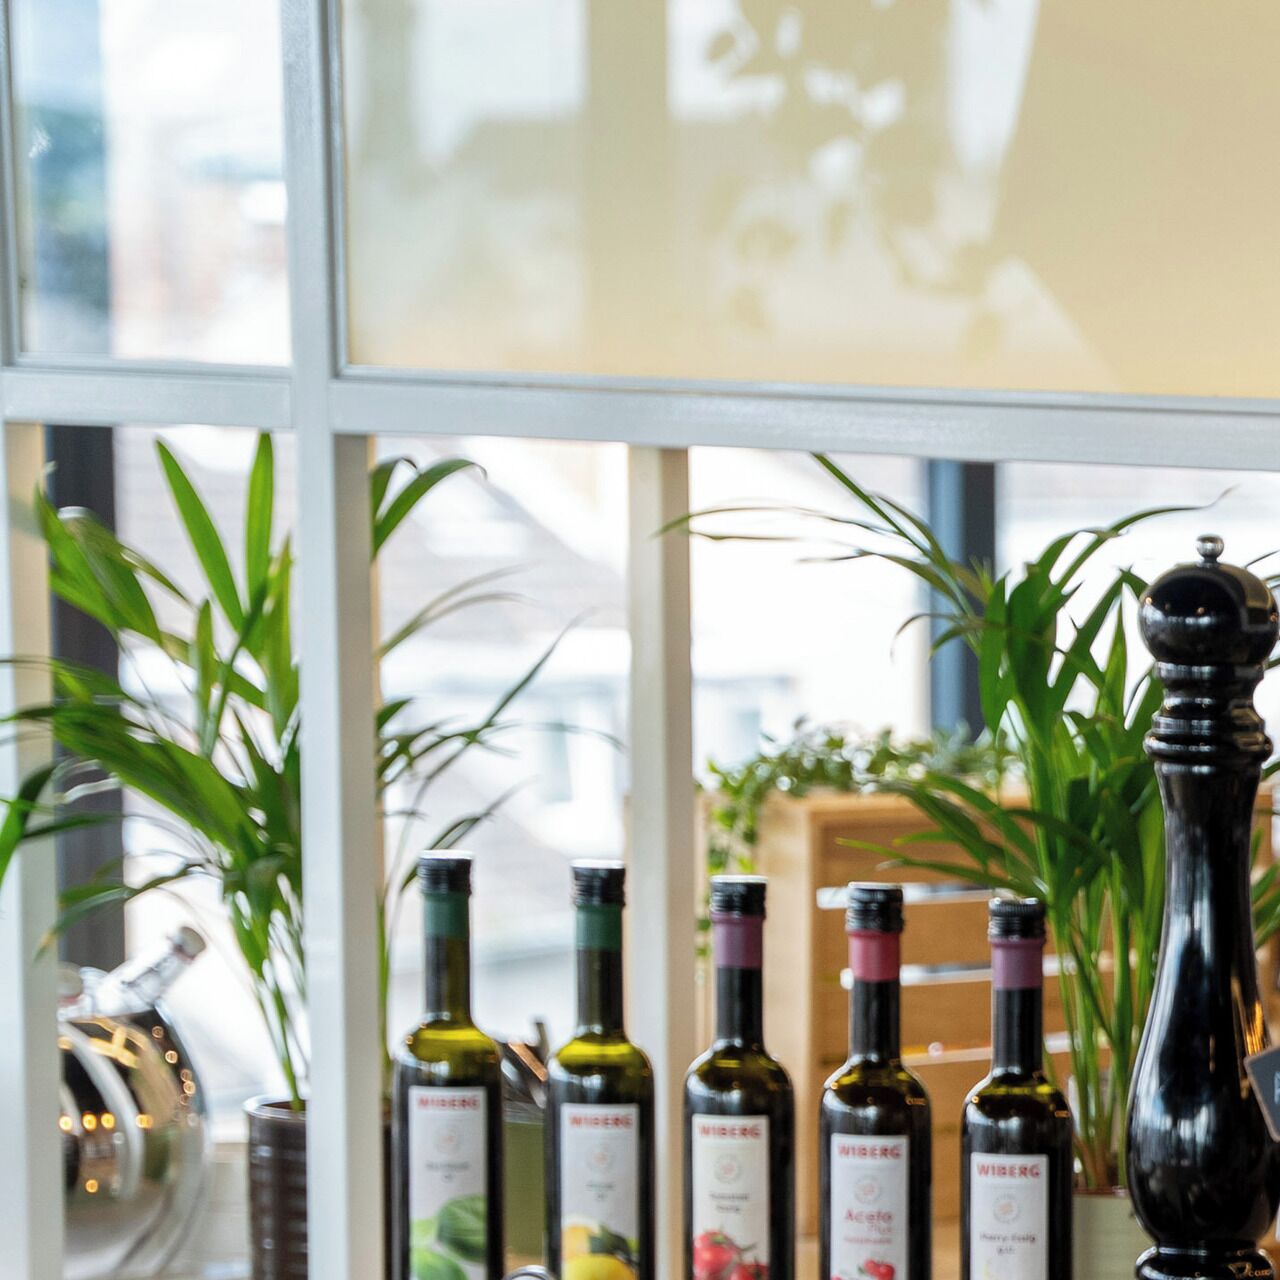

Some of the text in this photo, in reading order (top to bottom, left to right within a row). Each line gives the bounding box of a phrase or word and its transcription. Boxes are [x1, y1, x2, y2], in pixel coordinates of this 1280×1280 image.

[699, 1125, 761, 1139] WIBERG
[838, 1144, 902, 1160] WIBERG
[977, 1164, 1041, 1178] WIBERG
